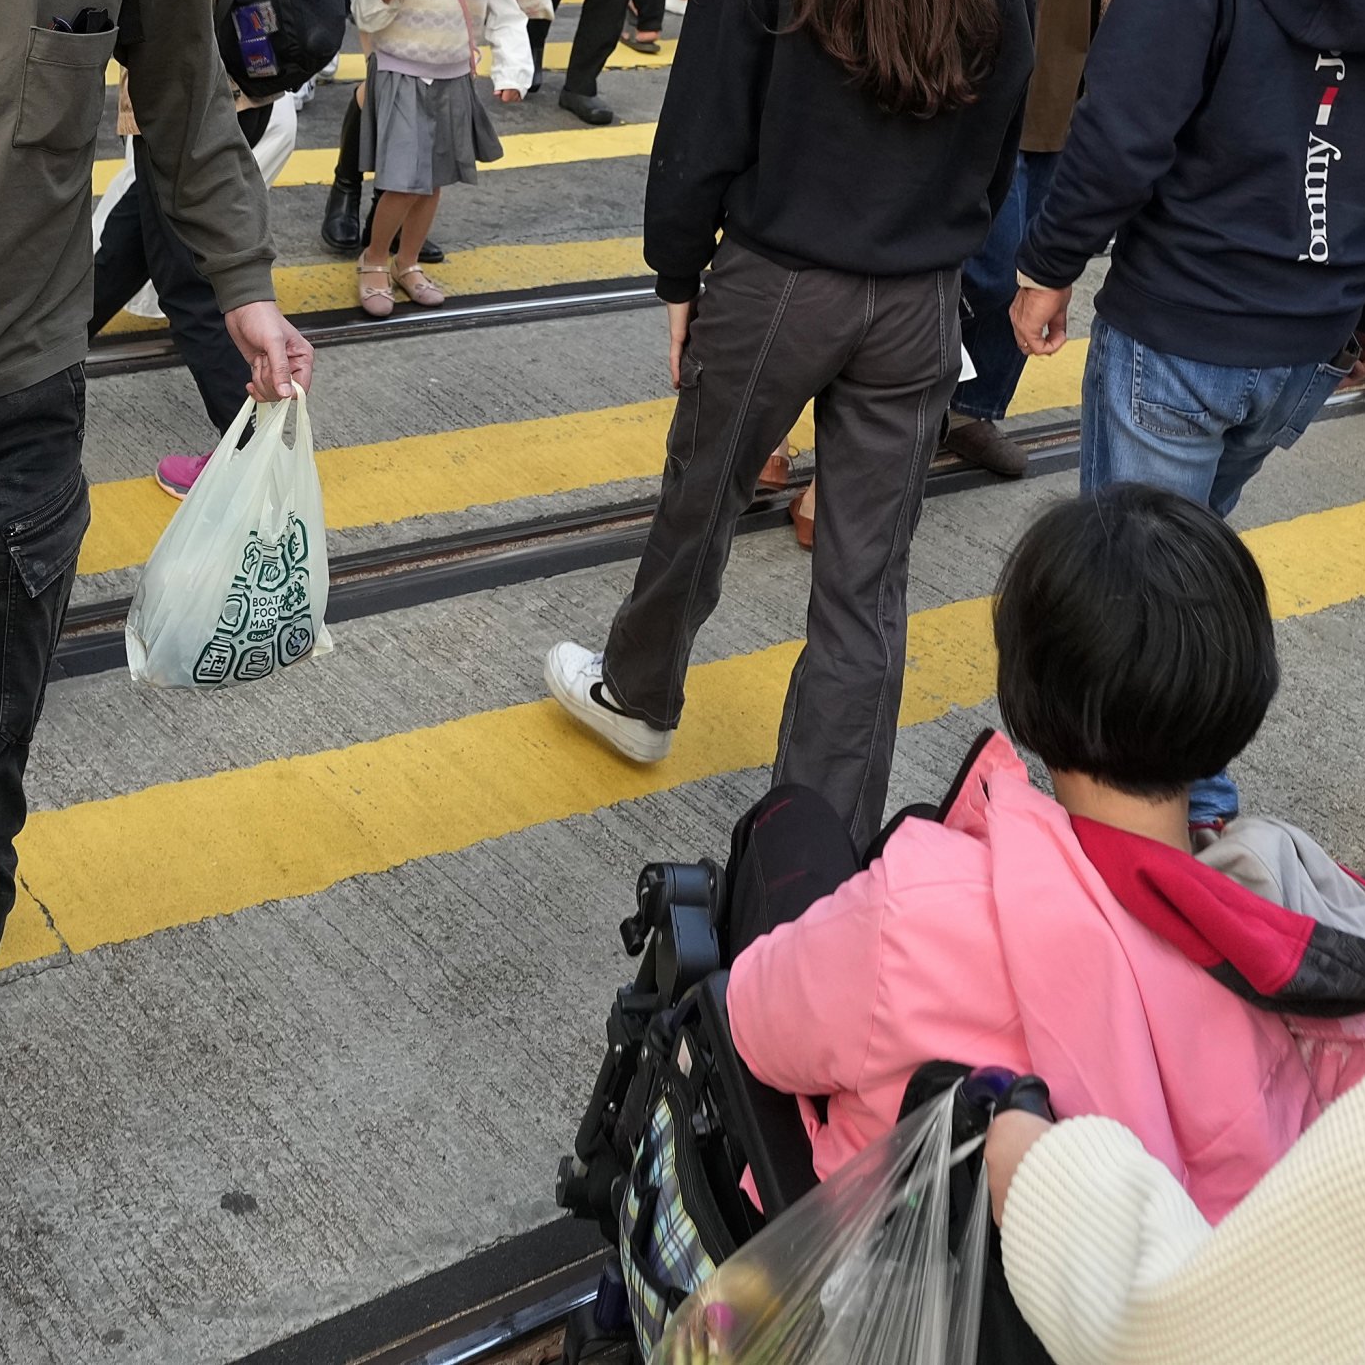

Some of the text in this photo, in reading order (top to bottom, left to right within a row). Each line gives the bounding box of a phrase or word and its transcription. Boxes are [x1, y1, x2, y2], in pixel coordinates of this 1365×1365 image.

[1298, 50, 1345, 265] ommy J
[253, 608, 278, 619] FOO
